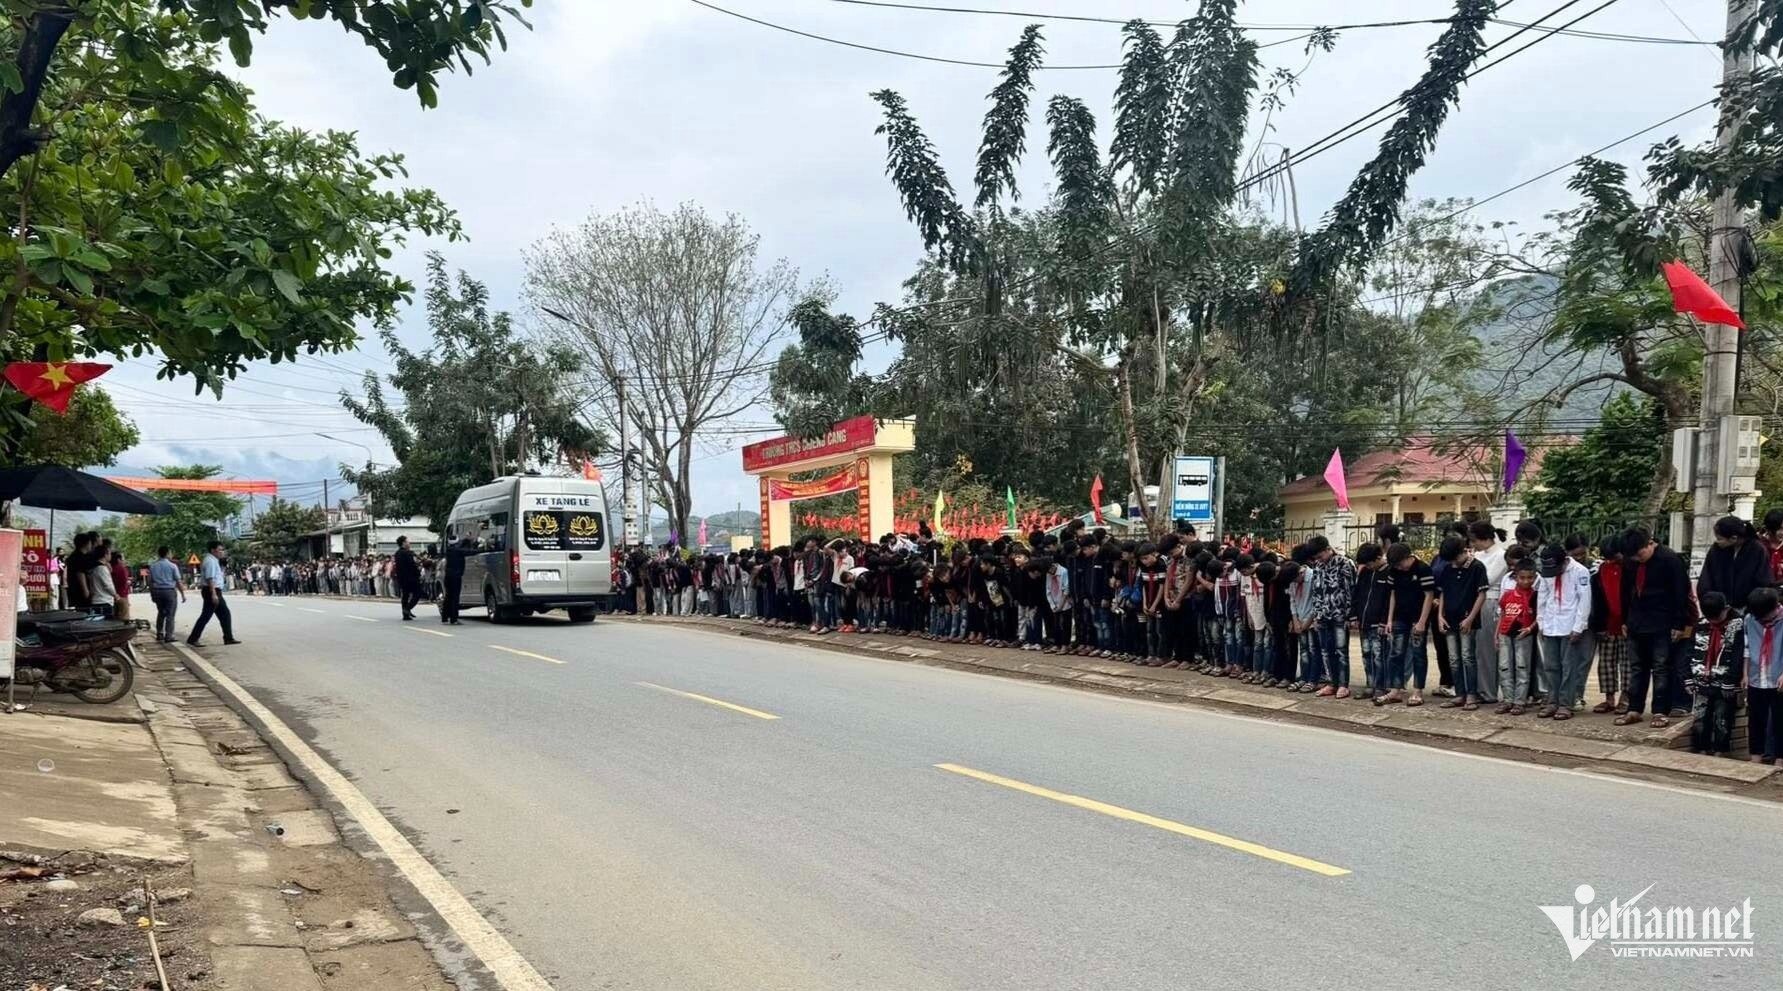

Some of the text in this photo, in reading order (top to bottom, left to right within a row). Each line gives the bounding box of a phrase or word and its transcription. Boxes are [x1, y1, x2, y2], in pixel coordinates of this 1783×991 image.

[535, 497, 548, 505] XE
[551, 497, 577, 506] TANG
[23, 535, 44, 548] NH
